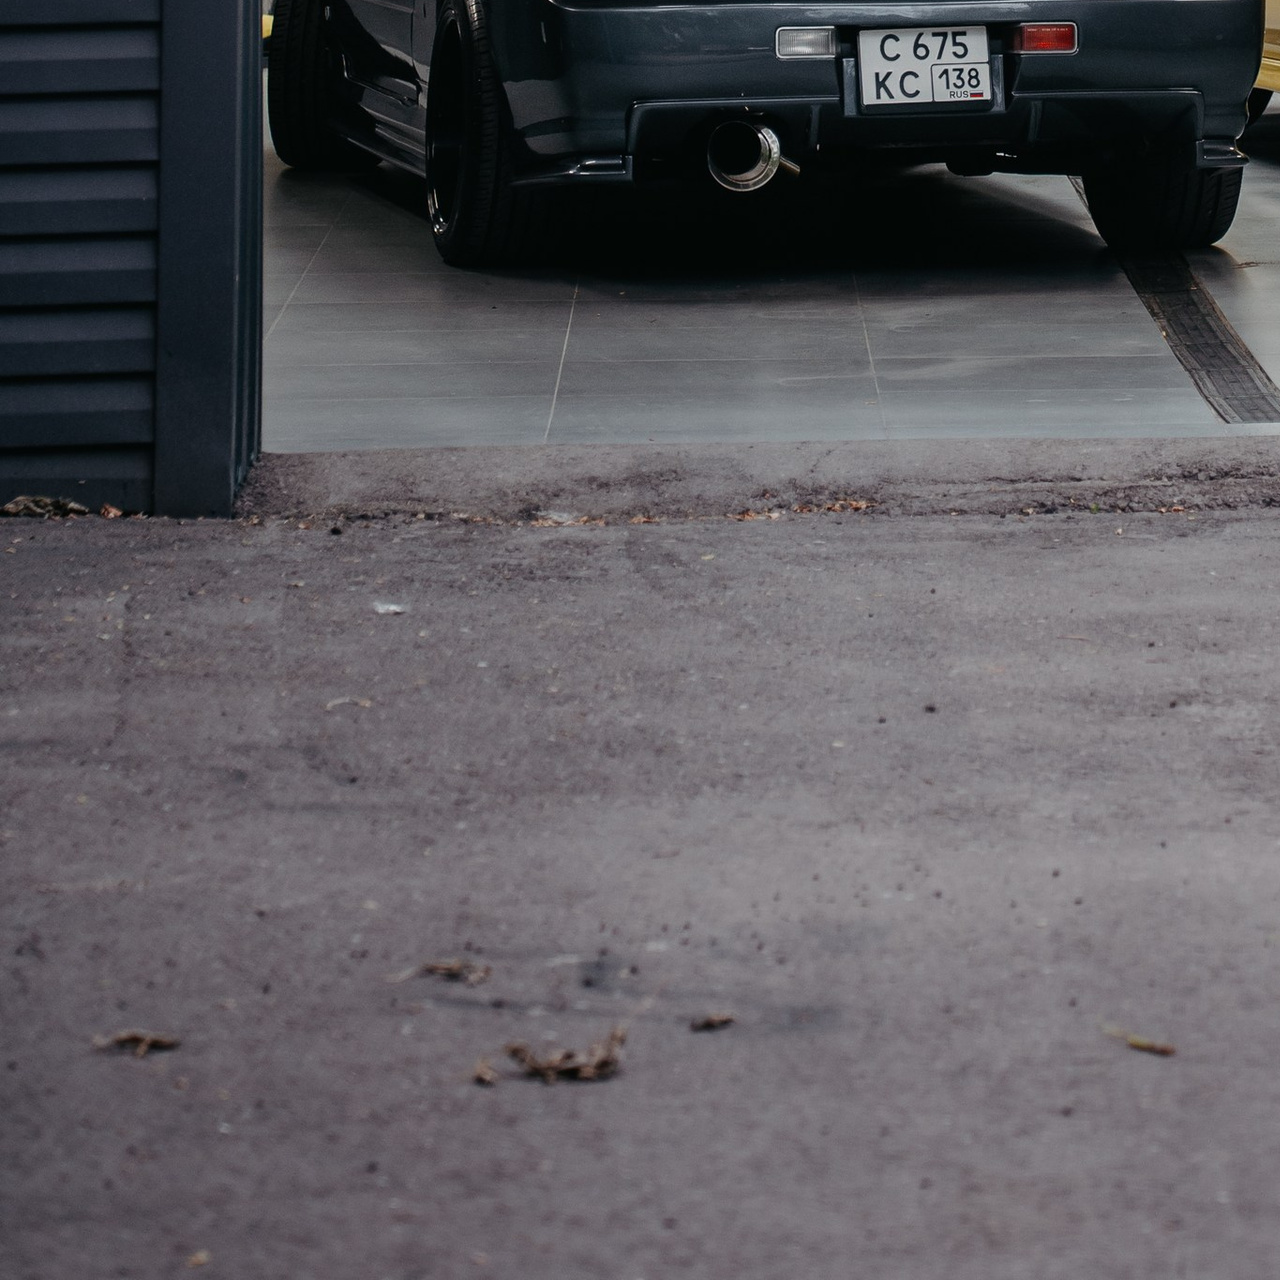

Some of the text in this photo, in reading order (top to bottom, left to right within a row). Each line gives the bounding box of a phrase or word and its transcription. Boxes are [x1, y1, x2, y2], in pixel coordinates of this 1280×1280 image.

[912, 30, 969, 61] 675
[938, 67, 981, 90] 138
[949, 90, 969, 99] RUS
